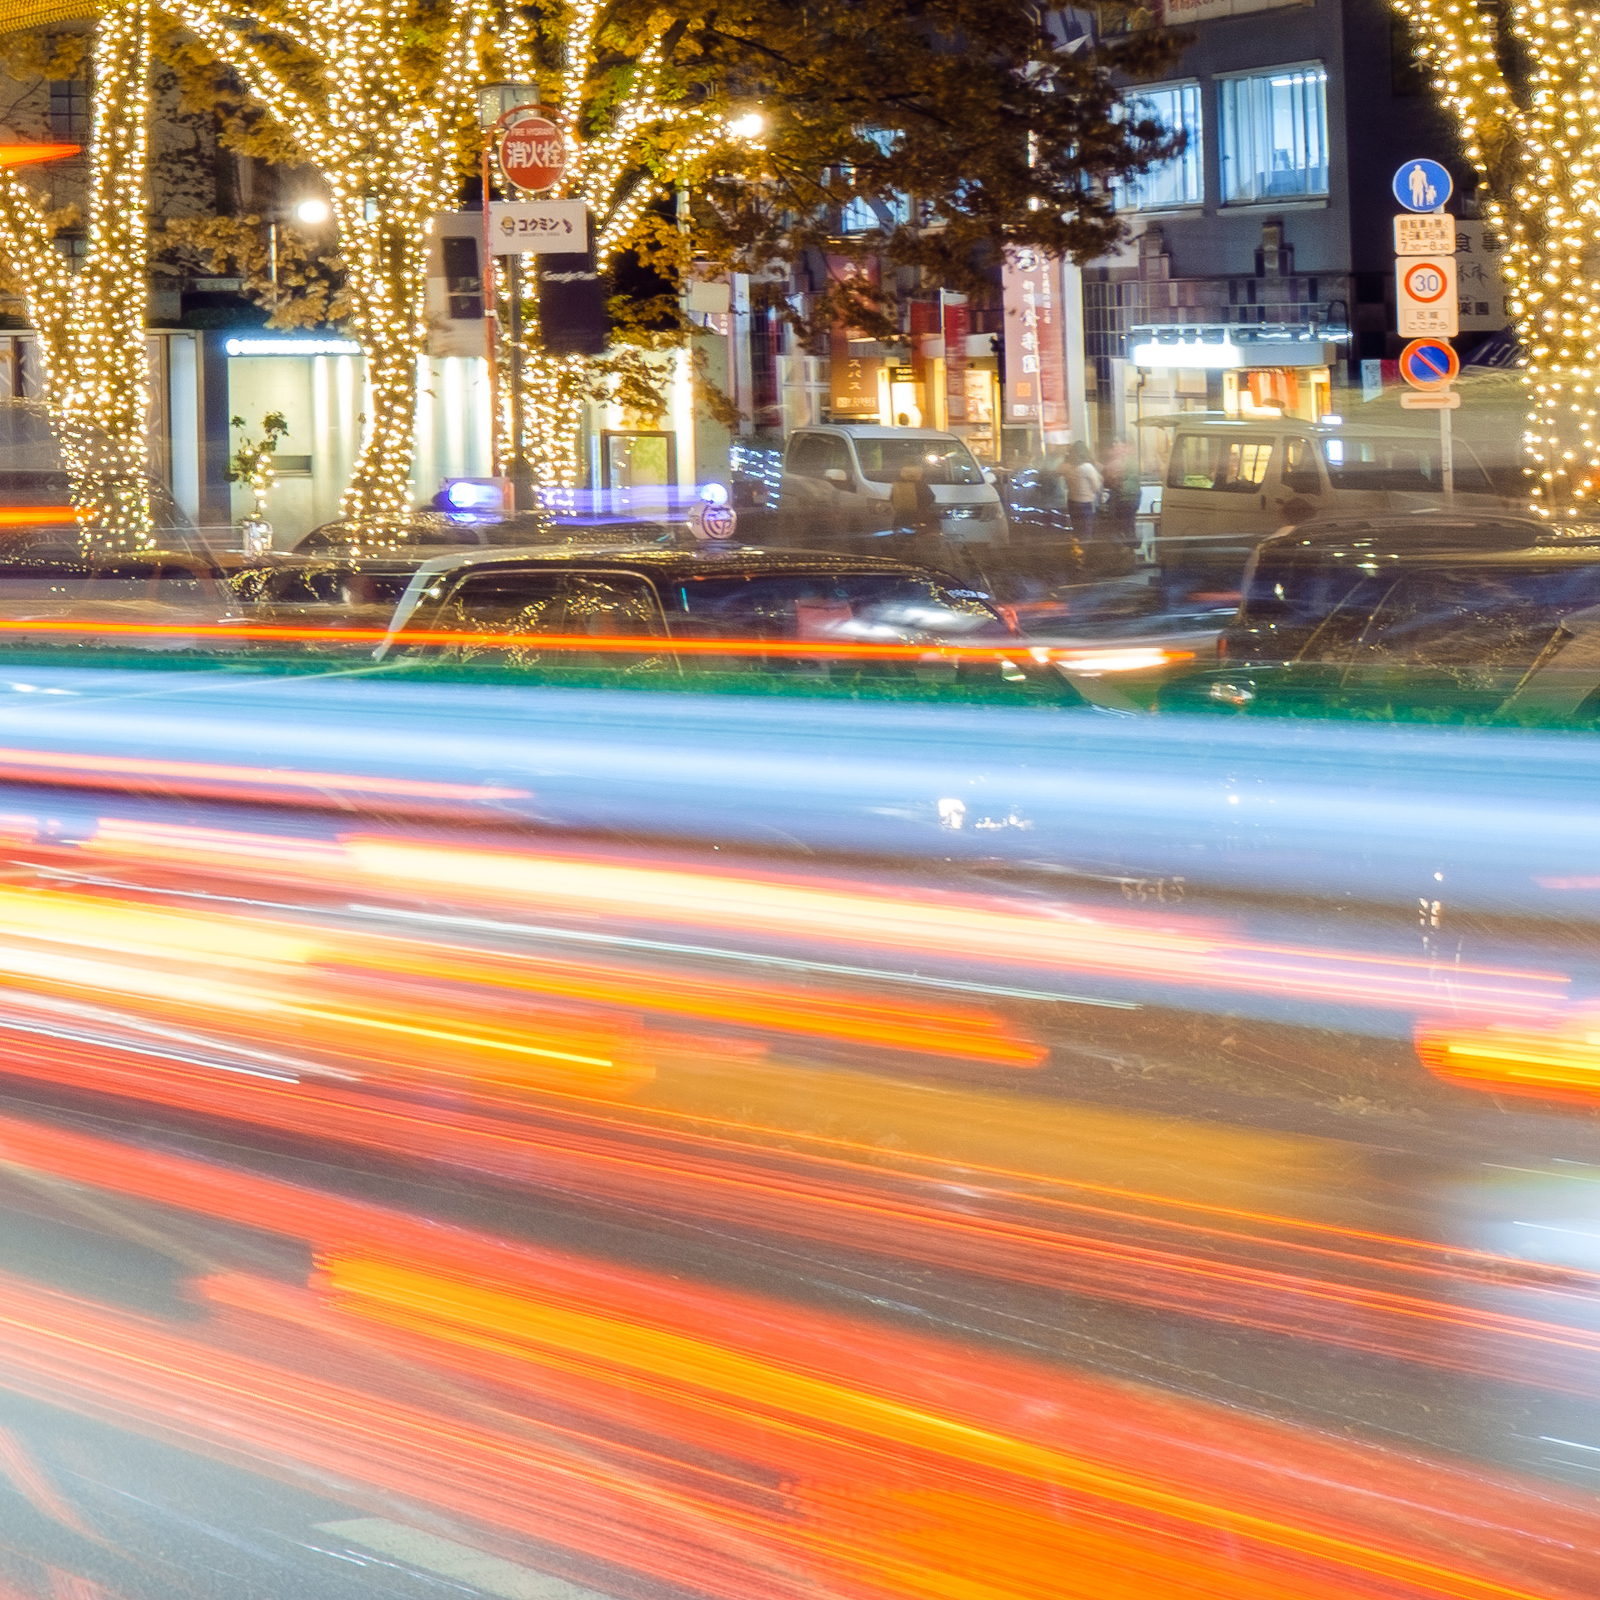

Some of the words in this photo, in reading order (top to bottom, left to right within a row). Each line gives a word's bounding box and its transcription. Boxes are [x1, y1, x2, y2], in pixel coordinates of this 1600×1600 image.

[506, 140, 563, 169] 消火栓
[518, 218, 560, 232] コクミン
[1414, 274, 1439, 292] 30
[1408, 320, 1449, 330] ここから
